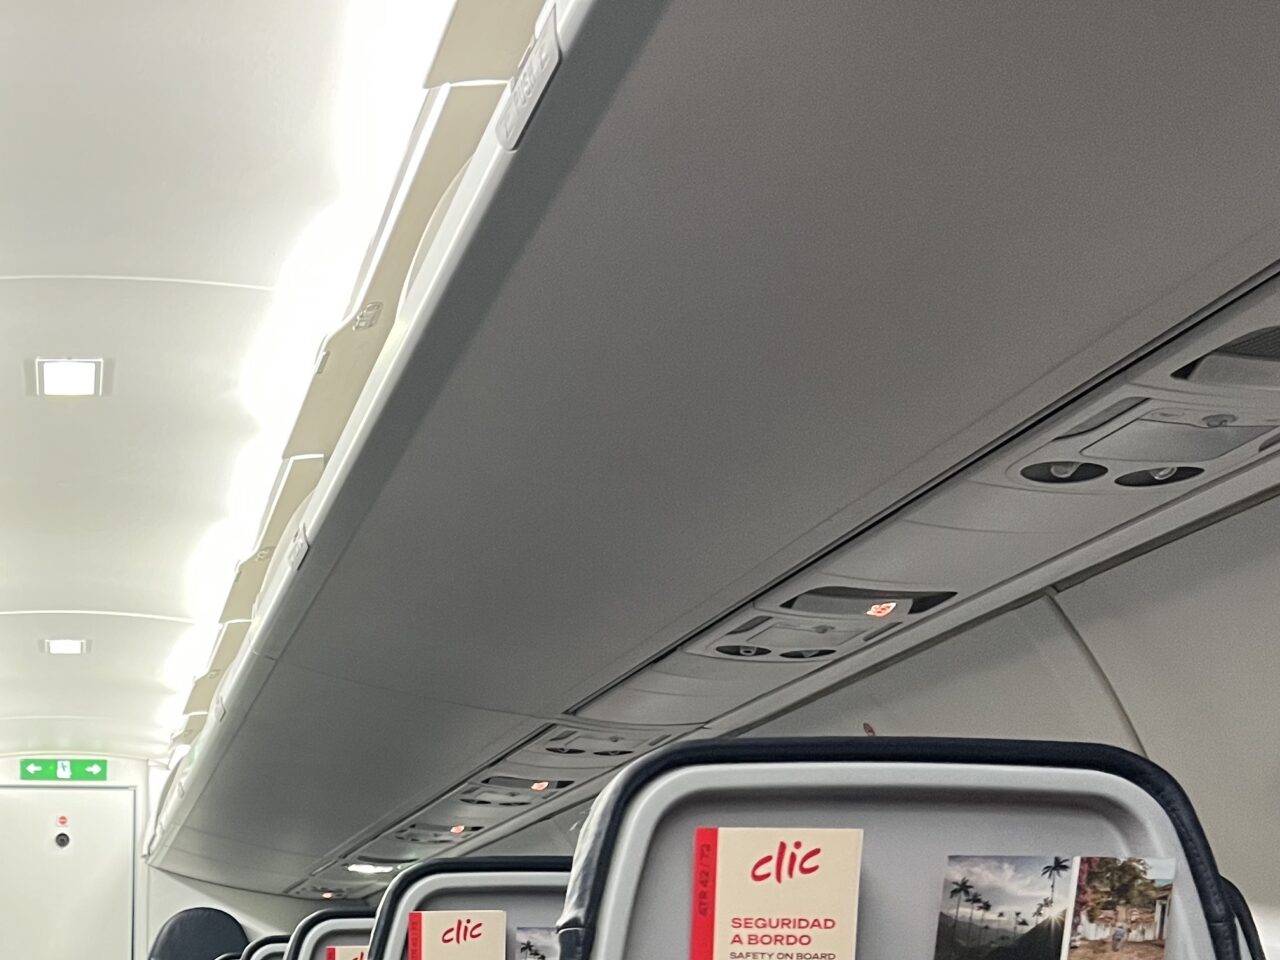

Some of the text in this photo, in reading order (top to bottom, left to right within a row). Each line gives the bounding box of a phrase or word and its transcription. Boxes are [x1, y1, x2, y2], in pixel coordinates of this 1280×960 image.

[751, 841, 821, 884] clic
[731, 917, 836, 930] SEGURIDAD
[441, 918, 483, 945] clic
[730, 935, 812, 945] A BORDO
[729, 952, 836, 960] SAFETY ON BOARD
